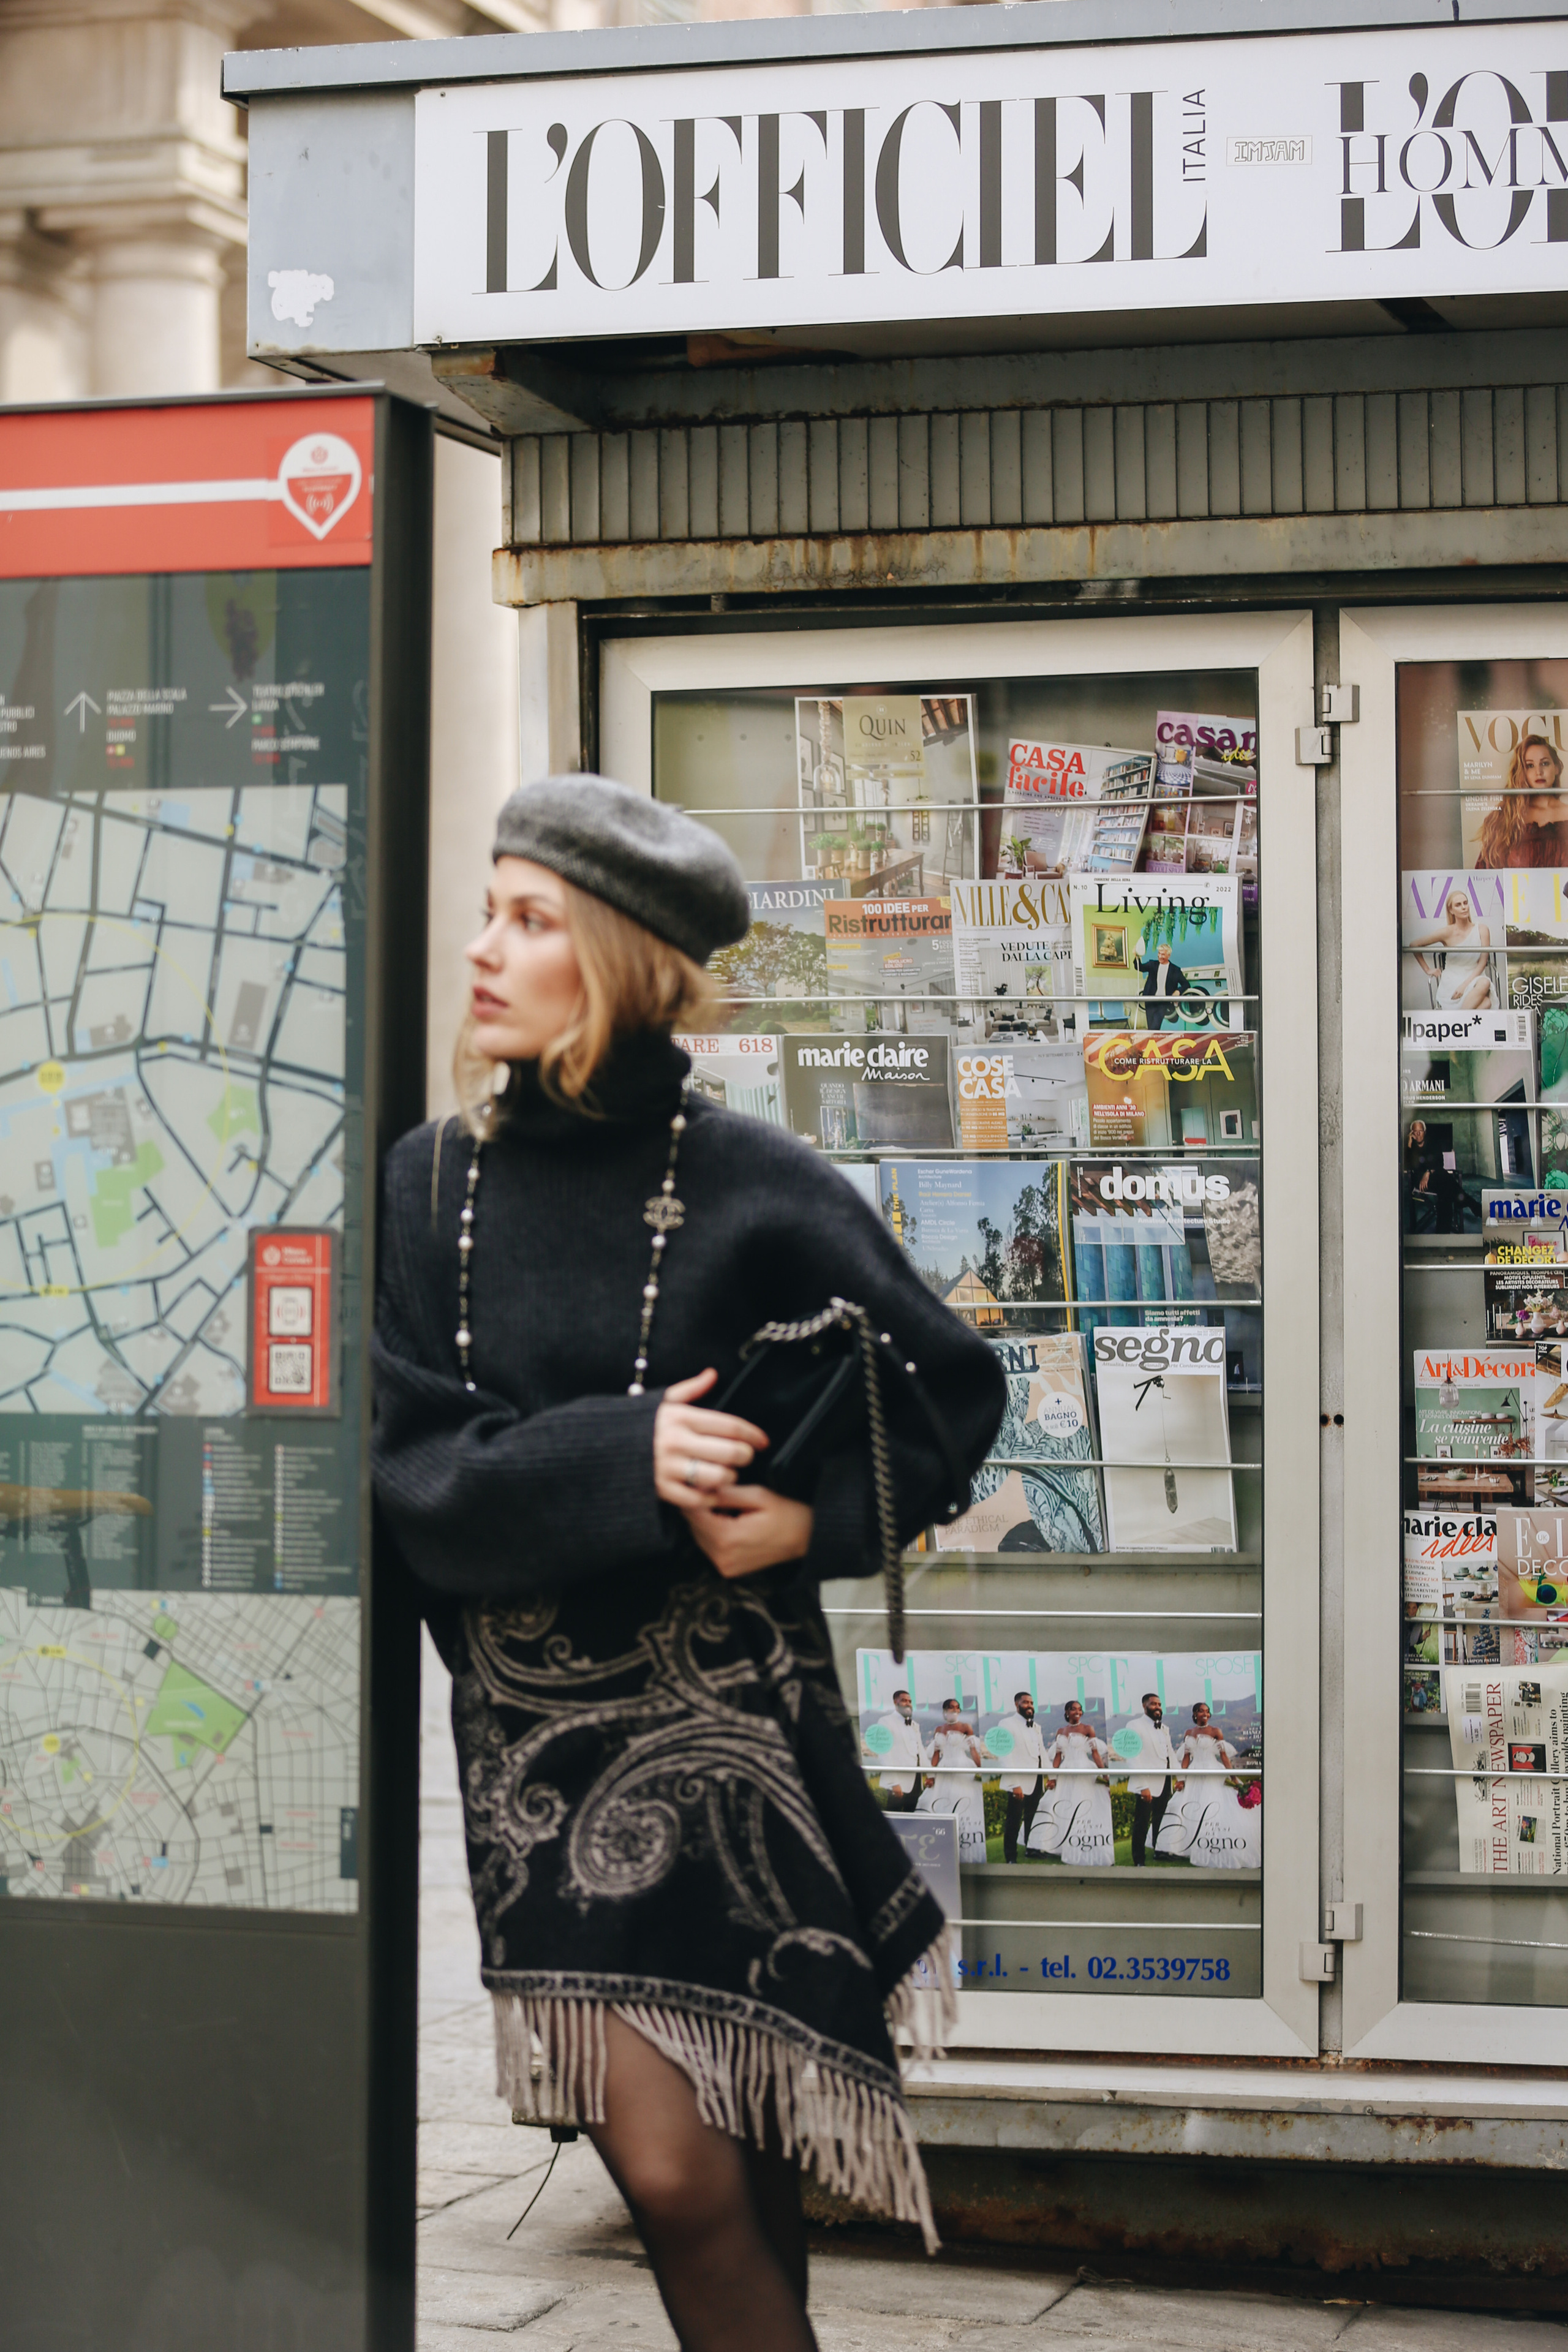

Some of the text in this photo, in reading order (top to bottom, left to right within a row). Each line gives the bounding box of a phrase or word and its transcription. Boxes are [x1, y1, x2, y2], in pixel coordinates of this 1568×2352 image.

[1183, 88, 1206, 182] ITALIA
[472, 91, 1207, 295] L'OFFICIEL
[859, 715, 906, 741] QUIN
[910, 750, 921, 761] 52
[1010, 744, 1086, 775] CASA
[1221, 744, 1251, 762] idee
[1008, 766, 1084, 798] facile
[862, 902, 929, 915] 100 IDEE PER
[1094, 883, 1210, 925] Living
[932, 940, 939, 951] 5
[1001, 941, 1050, 951] VEDUTE
[1002, 952, 1041, 962] DALLA
[1513, 994, 1544, 1006] RIDES
[739, 1038, 774, 1053] 618
[797, 1041, 929, 1067] marie claire
[957, 1055, 1014, 1077] COSE
[1098, 1038, 1235, 1082] CASA
[1139, 1057, 1200, 1066] RISTRUTTURARE
[861, 1066, 930, 1081] Maison
[959, 1076, 1022, 1099] CASA
[1410, 1080, 1446, 1092] ARMANI
[1099, 1166, 1231, 1200] domus
[1490, 1194, 1562, 1218] marie
[1497, 1245, 1555, 1256] CHANGEZ
[1497, 1256, 1511, 1264] DE
[1095, 1328, 1224, 1371] segno
[1044, 1411, 1077, 1421] BAGNO
[1419, 1419, 1491, 1434] La cuisine
[1434, 1435, 1448, 1444] se
[965, 1515, 1009, 1525] ETHICAL
[1421, 1527, 1495, 1558] idées
[1196, 1656, 1253, 1677] SPOSE
[1486, 1682, 1508, 1874] THE ART NEWSPAPER
[1549, 1709, 1562, 1875] National Portrait aims to
[957, 1953, 1231, 1981] s.r.l. tel. 02.3539758
